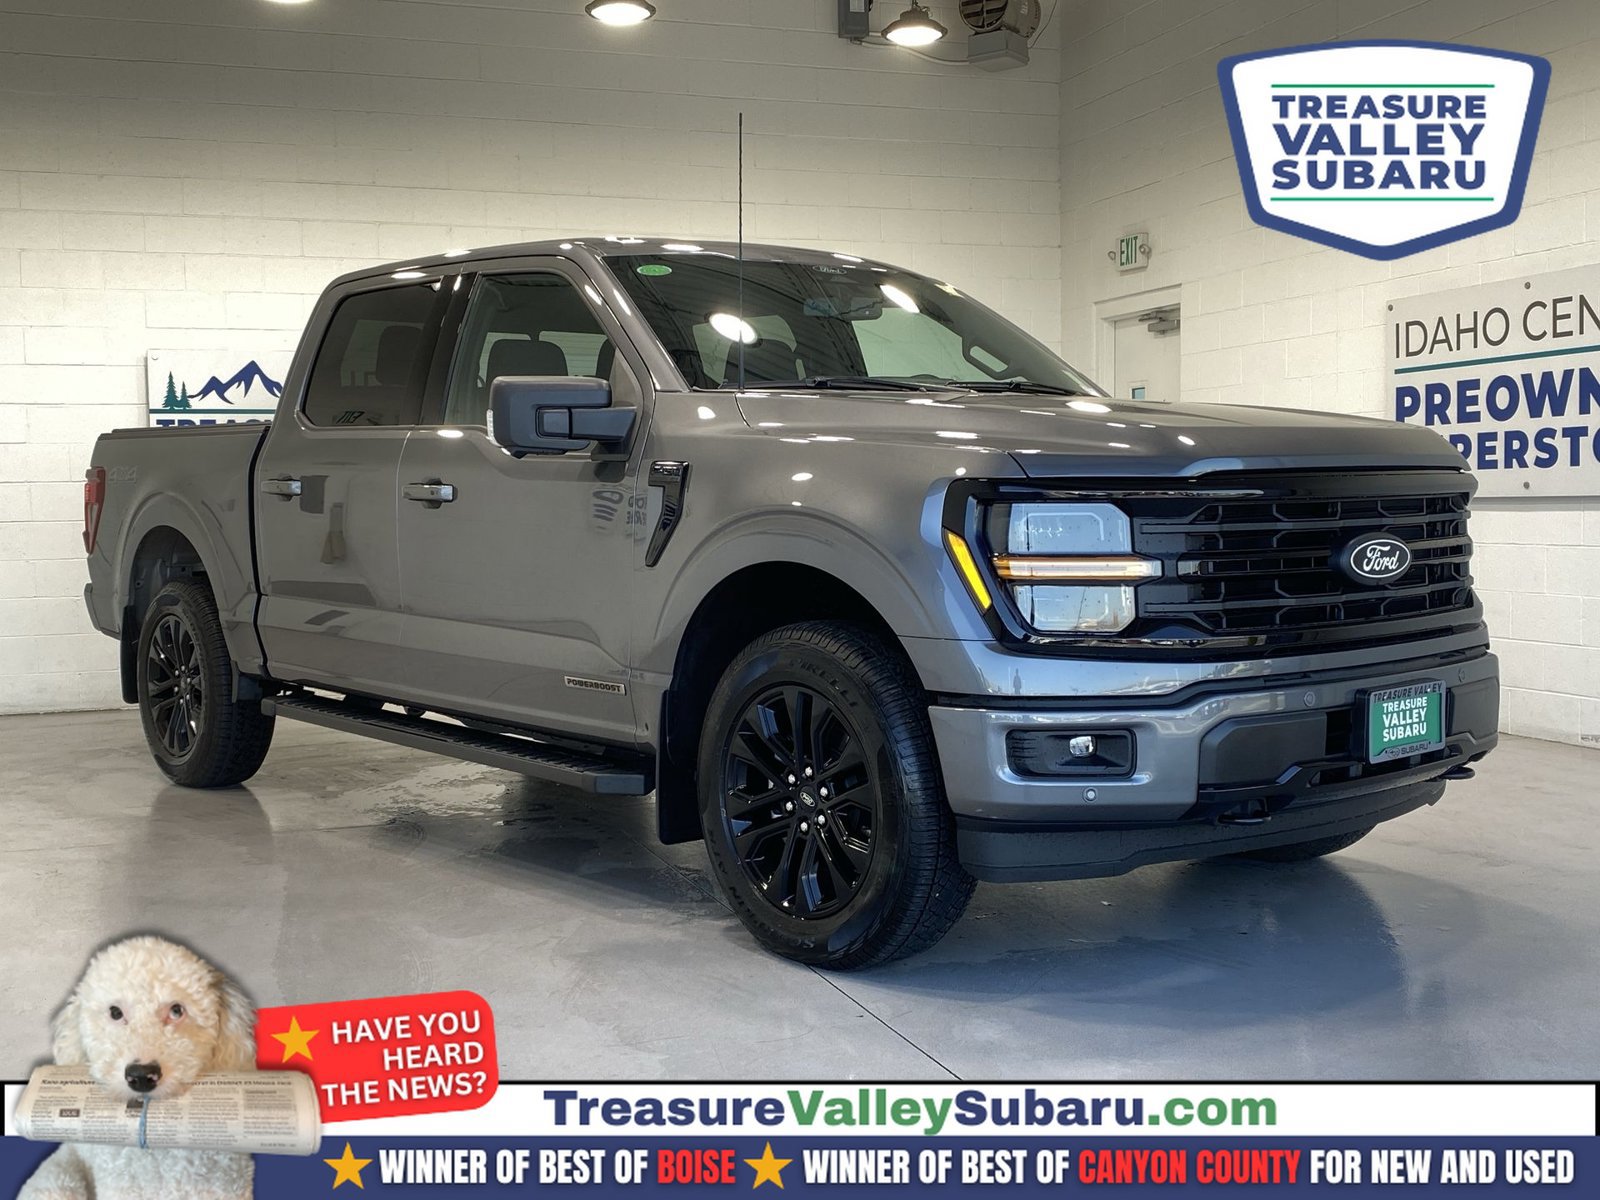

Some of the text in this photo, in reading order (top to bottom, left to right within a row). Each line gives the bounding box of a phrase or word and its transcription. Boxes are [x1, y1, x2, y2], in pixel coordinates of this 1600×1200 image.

[1119, 235, 1139, 267] EXIT
[1395, 293, 1600, 359] IDAHO CEN
[1448, 425, 1600, 470] PERST
[1362, 544, 1400, 572] Ford
[566, 677, 621, 693] POWERBOOST
[1373, 686, 1413, 704] TREASURE
[1382, 696, 1428, 714] TREASURE
[1382, 707, 1428, 728] VALLEY
[1382, 721, 1428, 742] SUBARU
[1400, 742, 1429, 755] SUBARU
